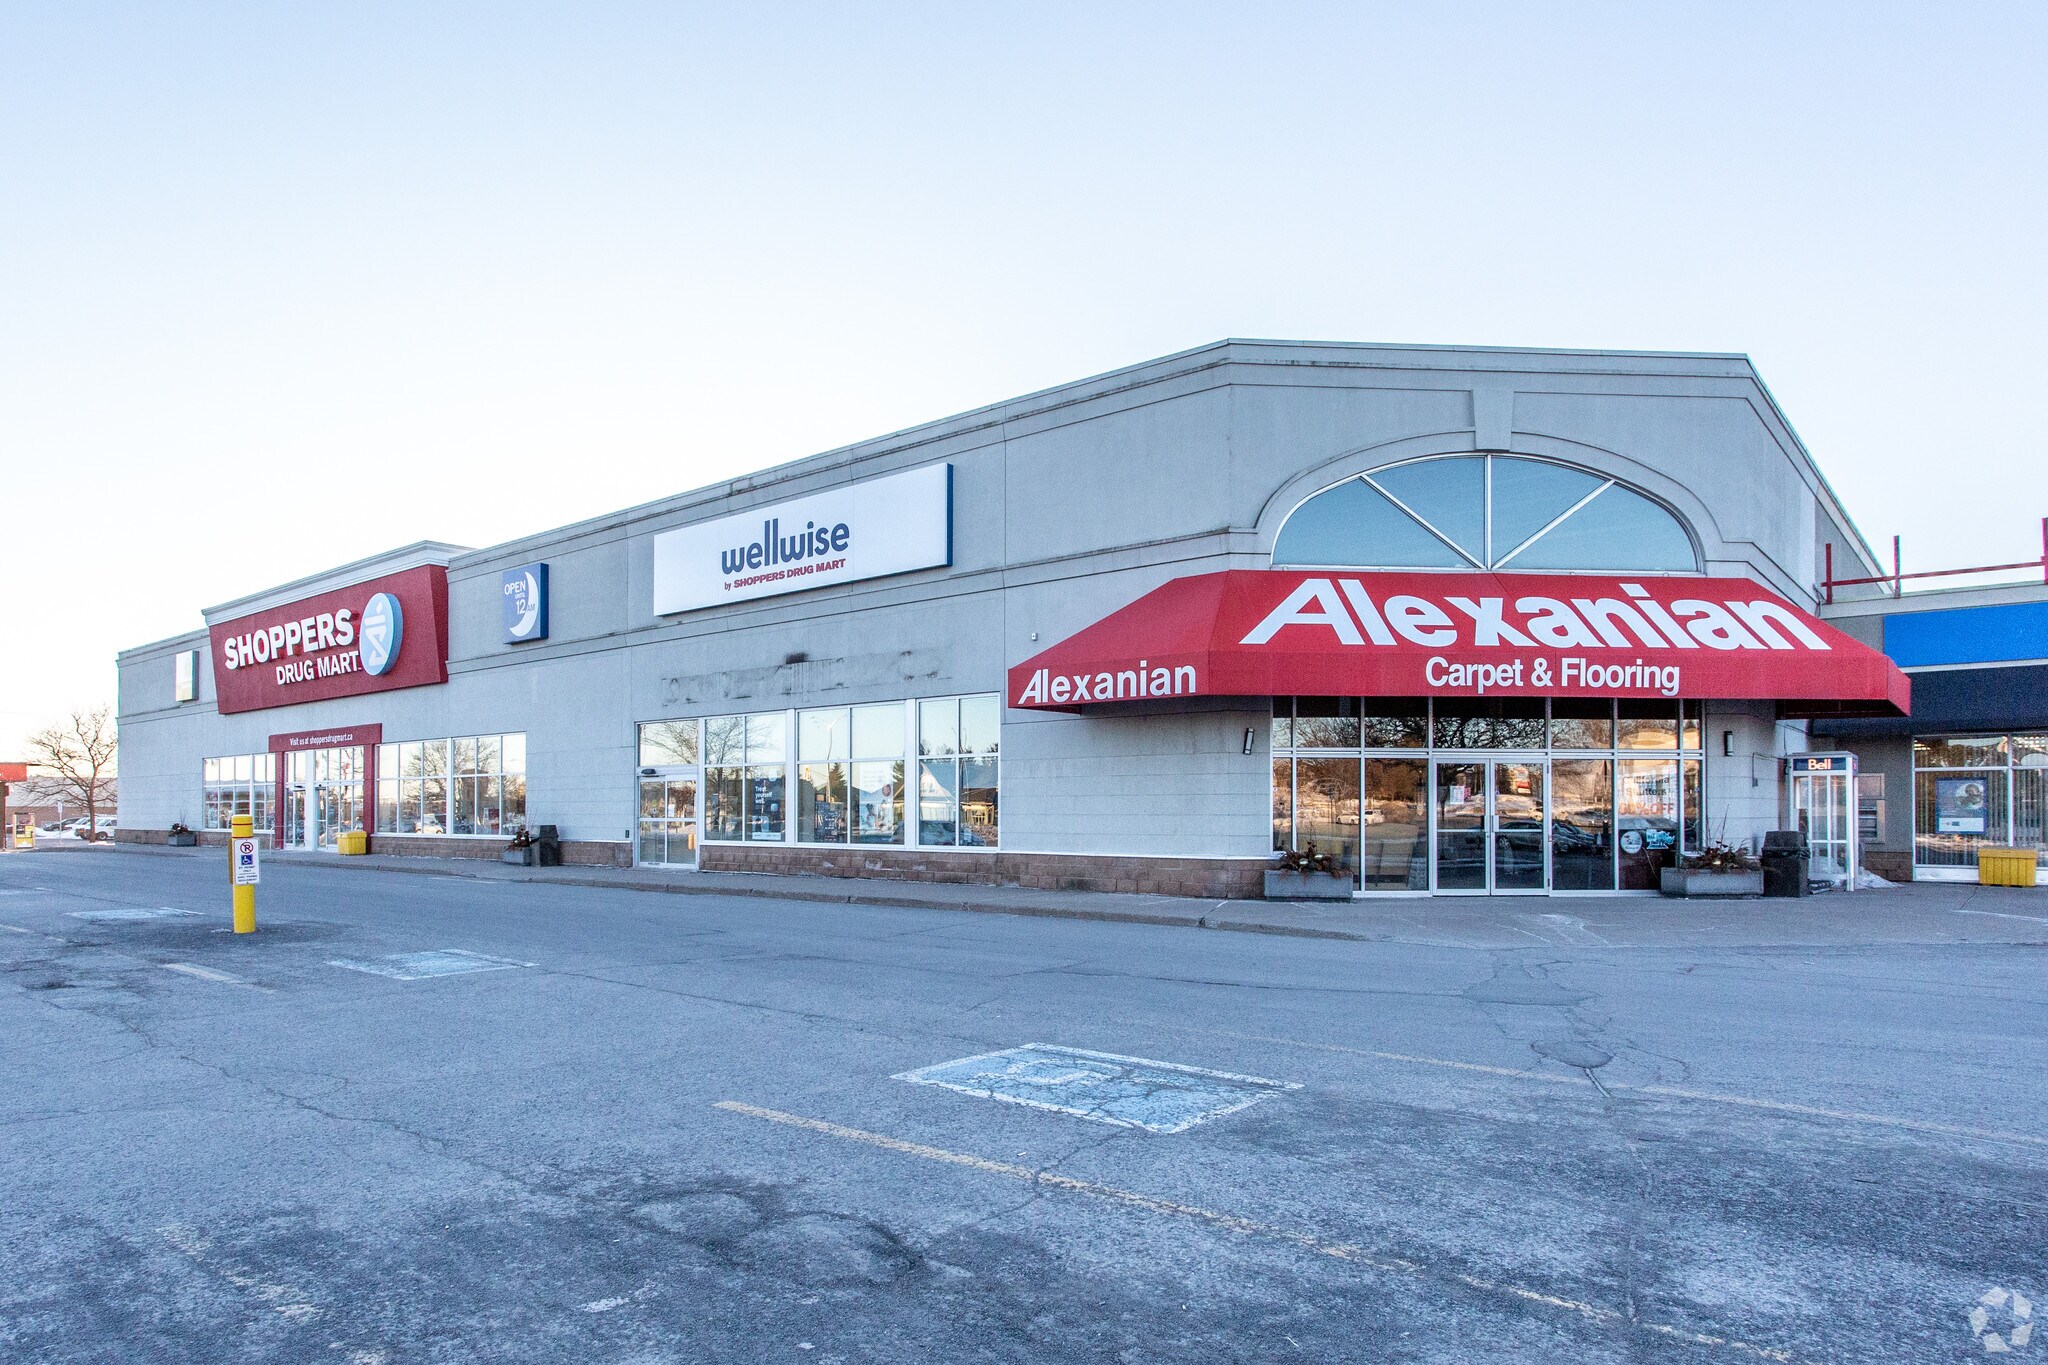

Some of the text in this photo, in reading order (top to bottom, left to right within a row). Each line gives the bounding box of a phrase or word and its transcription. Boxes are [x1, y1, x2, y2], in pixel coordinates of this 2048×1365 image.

[722, 518, 850, 574] wellwise
[504, 580, 526, 595] OPEN
[724, 558, 846, 591] by SHOPPERS DRUG MART
[516, 599, 536, 614] 12 AM
[1238, 578, 1833, 650] Alexanian
[224, 608, 355, 670] SHOPPERS
[276, 651, 359, 685] DRUG MART
[1017, 660, 1196, 705] Alexanian
[1425, 656, 1680, 696] Carpet & Flooring
[290, 737, 299, 746] Visit
[310, 733, 353, 745] shoppersdrugmart.ca
[1623, 774, 1670, 784] Clifornia
[1808, 758, 1832, 770] Bell
[1626, 787, 1667, 796] Sutters
